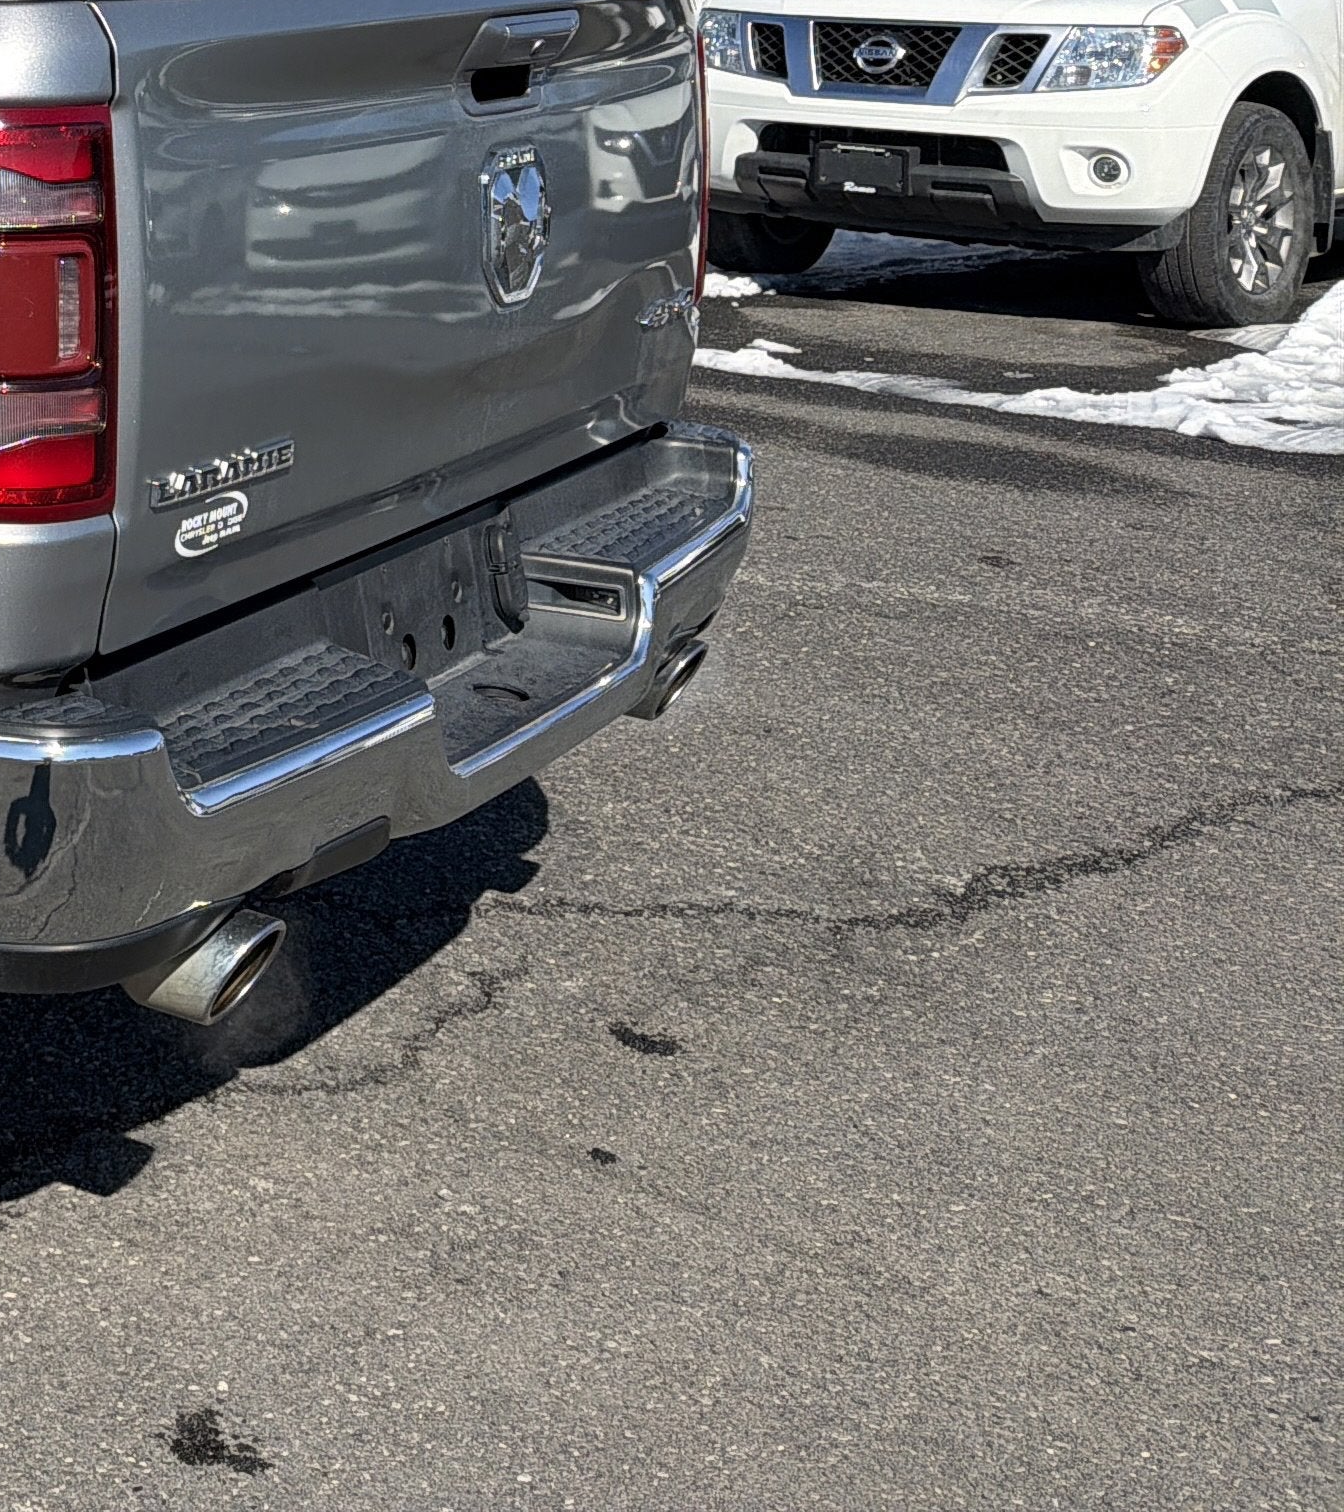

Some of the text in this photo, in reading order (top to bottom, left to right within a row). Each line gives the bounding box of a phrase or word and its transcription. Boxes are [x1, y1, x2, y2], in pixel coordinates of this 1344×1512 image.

[146, 438, 295, 510] LARAMIE
[181, 512, 209, 533] ROCKY
[209, 502, 238, 523] MOUNT
